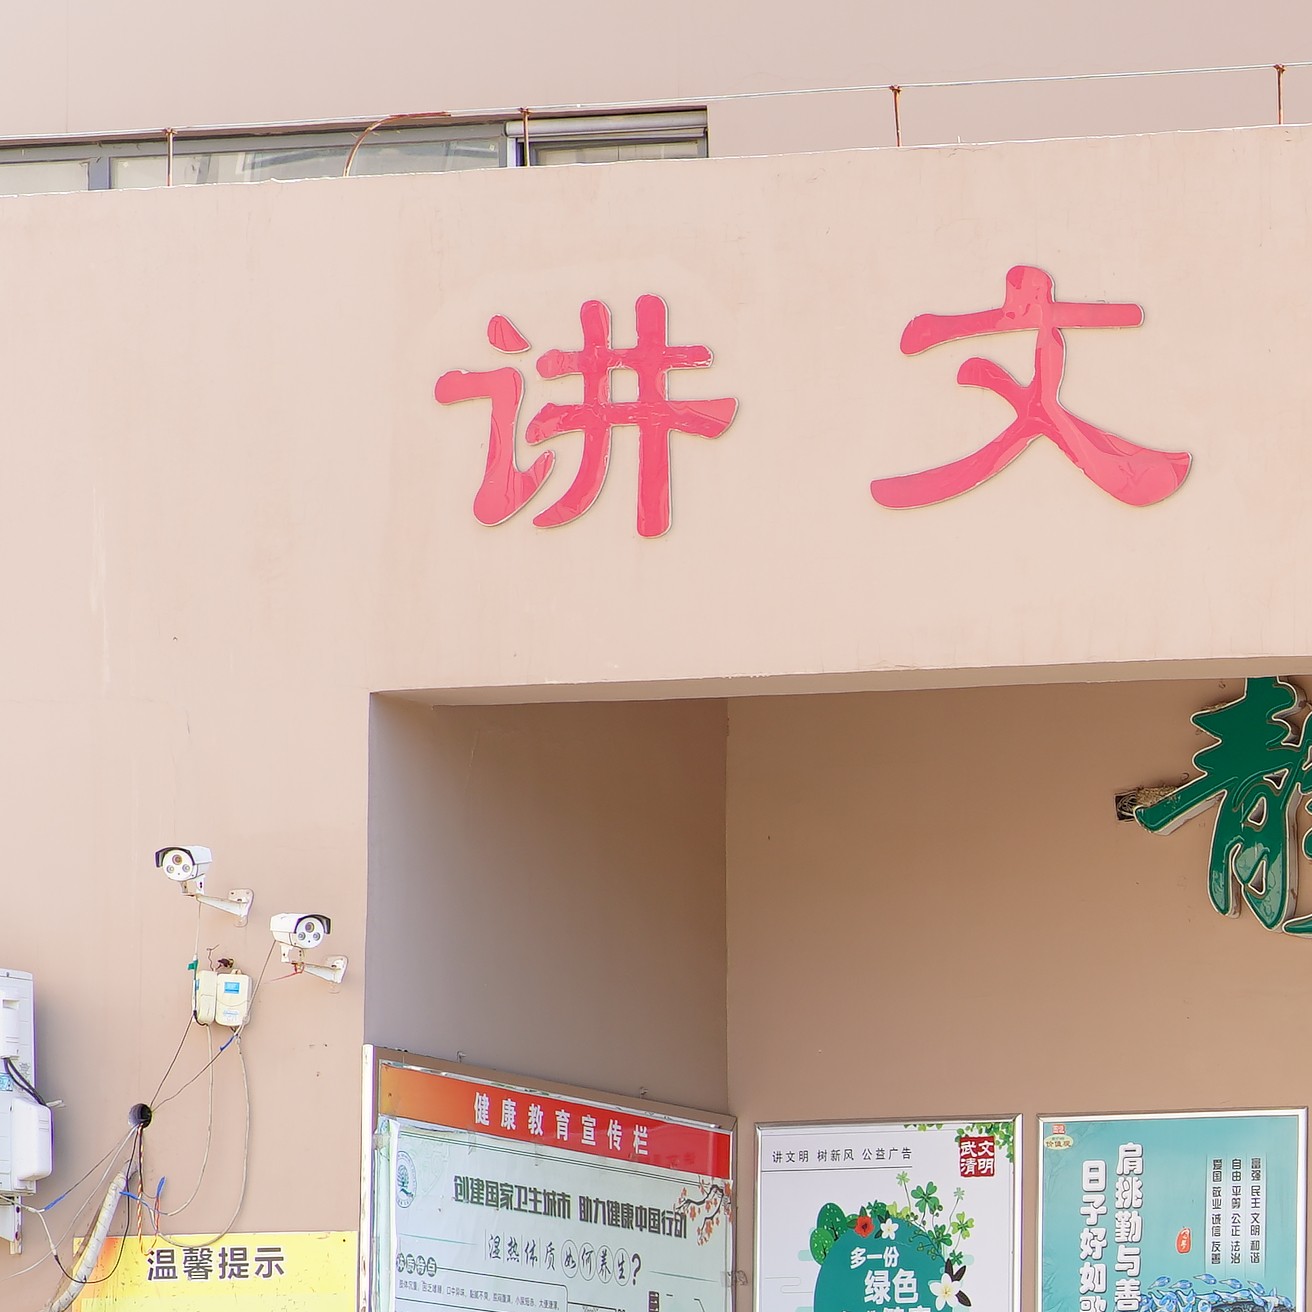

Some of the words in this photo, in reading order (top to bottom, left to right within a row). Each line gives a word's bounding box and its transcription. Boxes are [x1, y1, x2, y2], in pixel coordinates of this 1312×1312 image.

[473, 1091, 649, 1155] 健康教育宣传栏
[772, 1150, 809, 1163] 讲文明
[817, 1148, 854, 1161] 树新风
[862, 1147, 912, 1160] 公益广告
[453, 1175, 571, 1220] 创建国家卫生城市
[579, 1195, 687, 1239] 助力健康中国行动
[1114, 1142, 1143, 1312] 肩挑勤与善
[147, 1246, 286, 1281] 温馨提示
[850, 1246, 900, 1269] 多一份
[864, 1268, 919, 1305] 绿色
